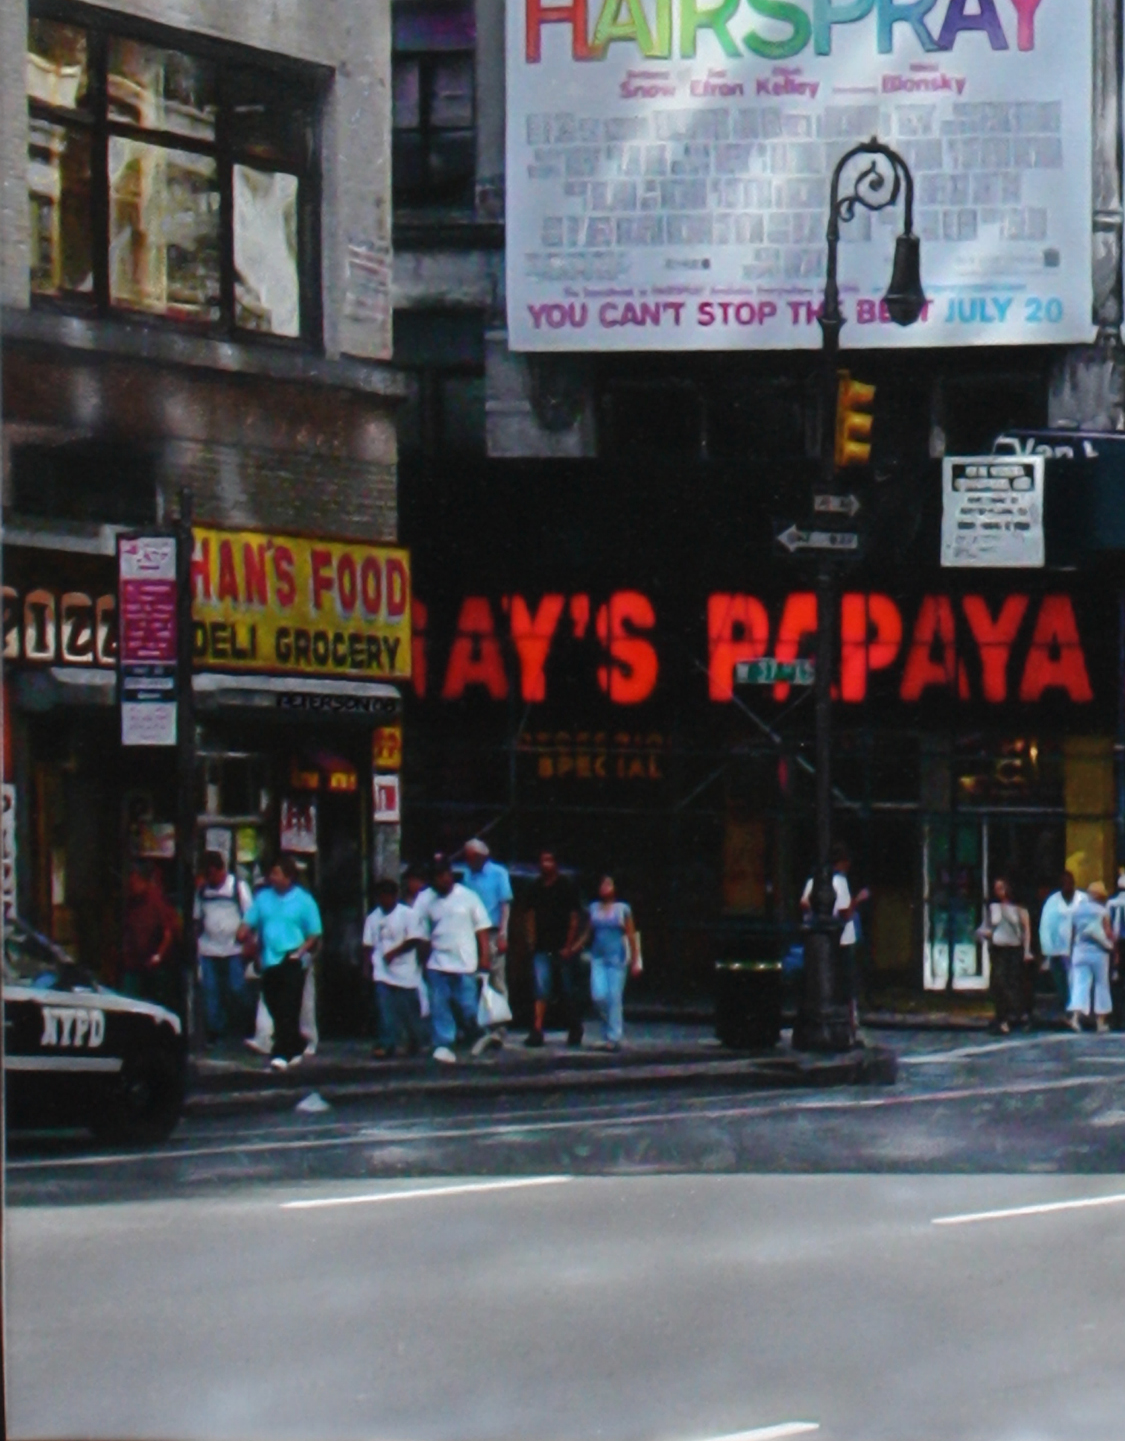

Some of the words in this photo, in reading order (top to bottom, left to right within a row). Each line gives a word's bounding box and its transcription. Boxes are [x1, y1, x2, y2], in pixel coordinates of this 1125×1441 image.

[527, 303, 588, 330] YOU
[600, 301, 686, 329] CAN'T
[697, 301, 778, 326] STOP
[786, 301, 844, 325] TH
[944, 296, 1015, 325] JULY
[1024, 296, 1063, 324] 20
[310, 546, 409, 619] FOOD
[275, 627, 402, 672] GROCERY
